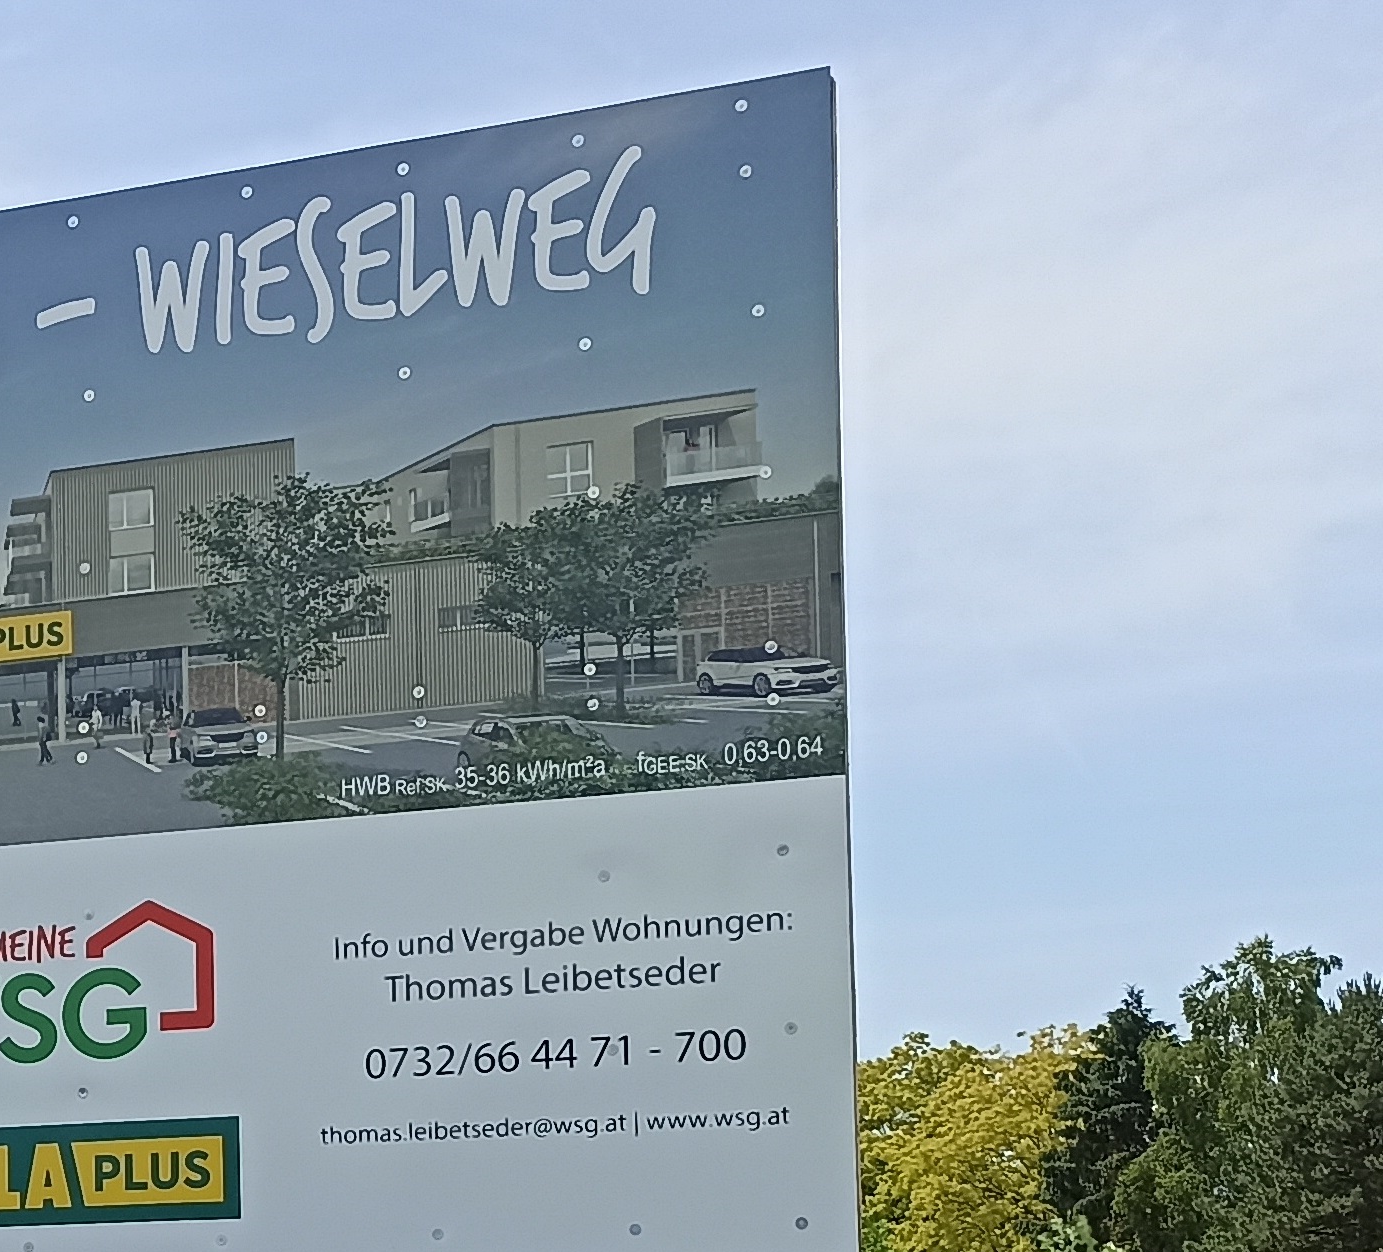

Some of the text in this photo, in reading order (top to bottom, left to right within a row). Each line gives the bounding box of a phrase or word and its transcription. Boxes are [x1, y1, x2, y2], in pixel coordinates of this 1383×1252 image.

[134, 145, 657, 354] WIESELWEG
[341, 774, 390, 799] HWB
[454, 762, 511, 789] 35-36
[723, 735, 824, 767] 0,63-0,64
[334, 909, 793, 961] Info und Vergabe Wohnungen:
[383, 955, 722, 1003] Thomas Leibetseder
[365, 1040, 520, 1080] 0732/66
[530, 1038, 578, 1070] 44
[590, 1035, 631, 1068] 71
[674, 1028, 747, 1064] 700
[320, 1113, 627, 1146] thomas.leibetseder@wsg.at
[646, 1106, 790, 1134] www.wsg.at
[94, 1149, 211, 1193] PLUS
